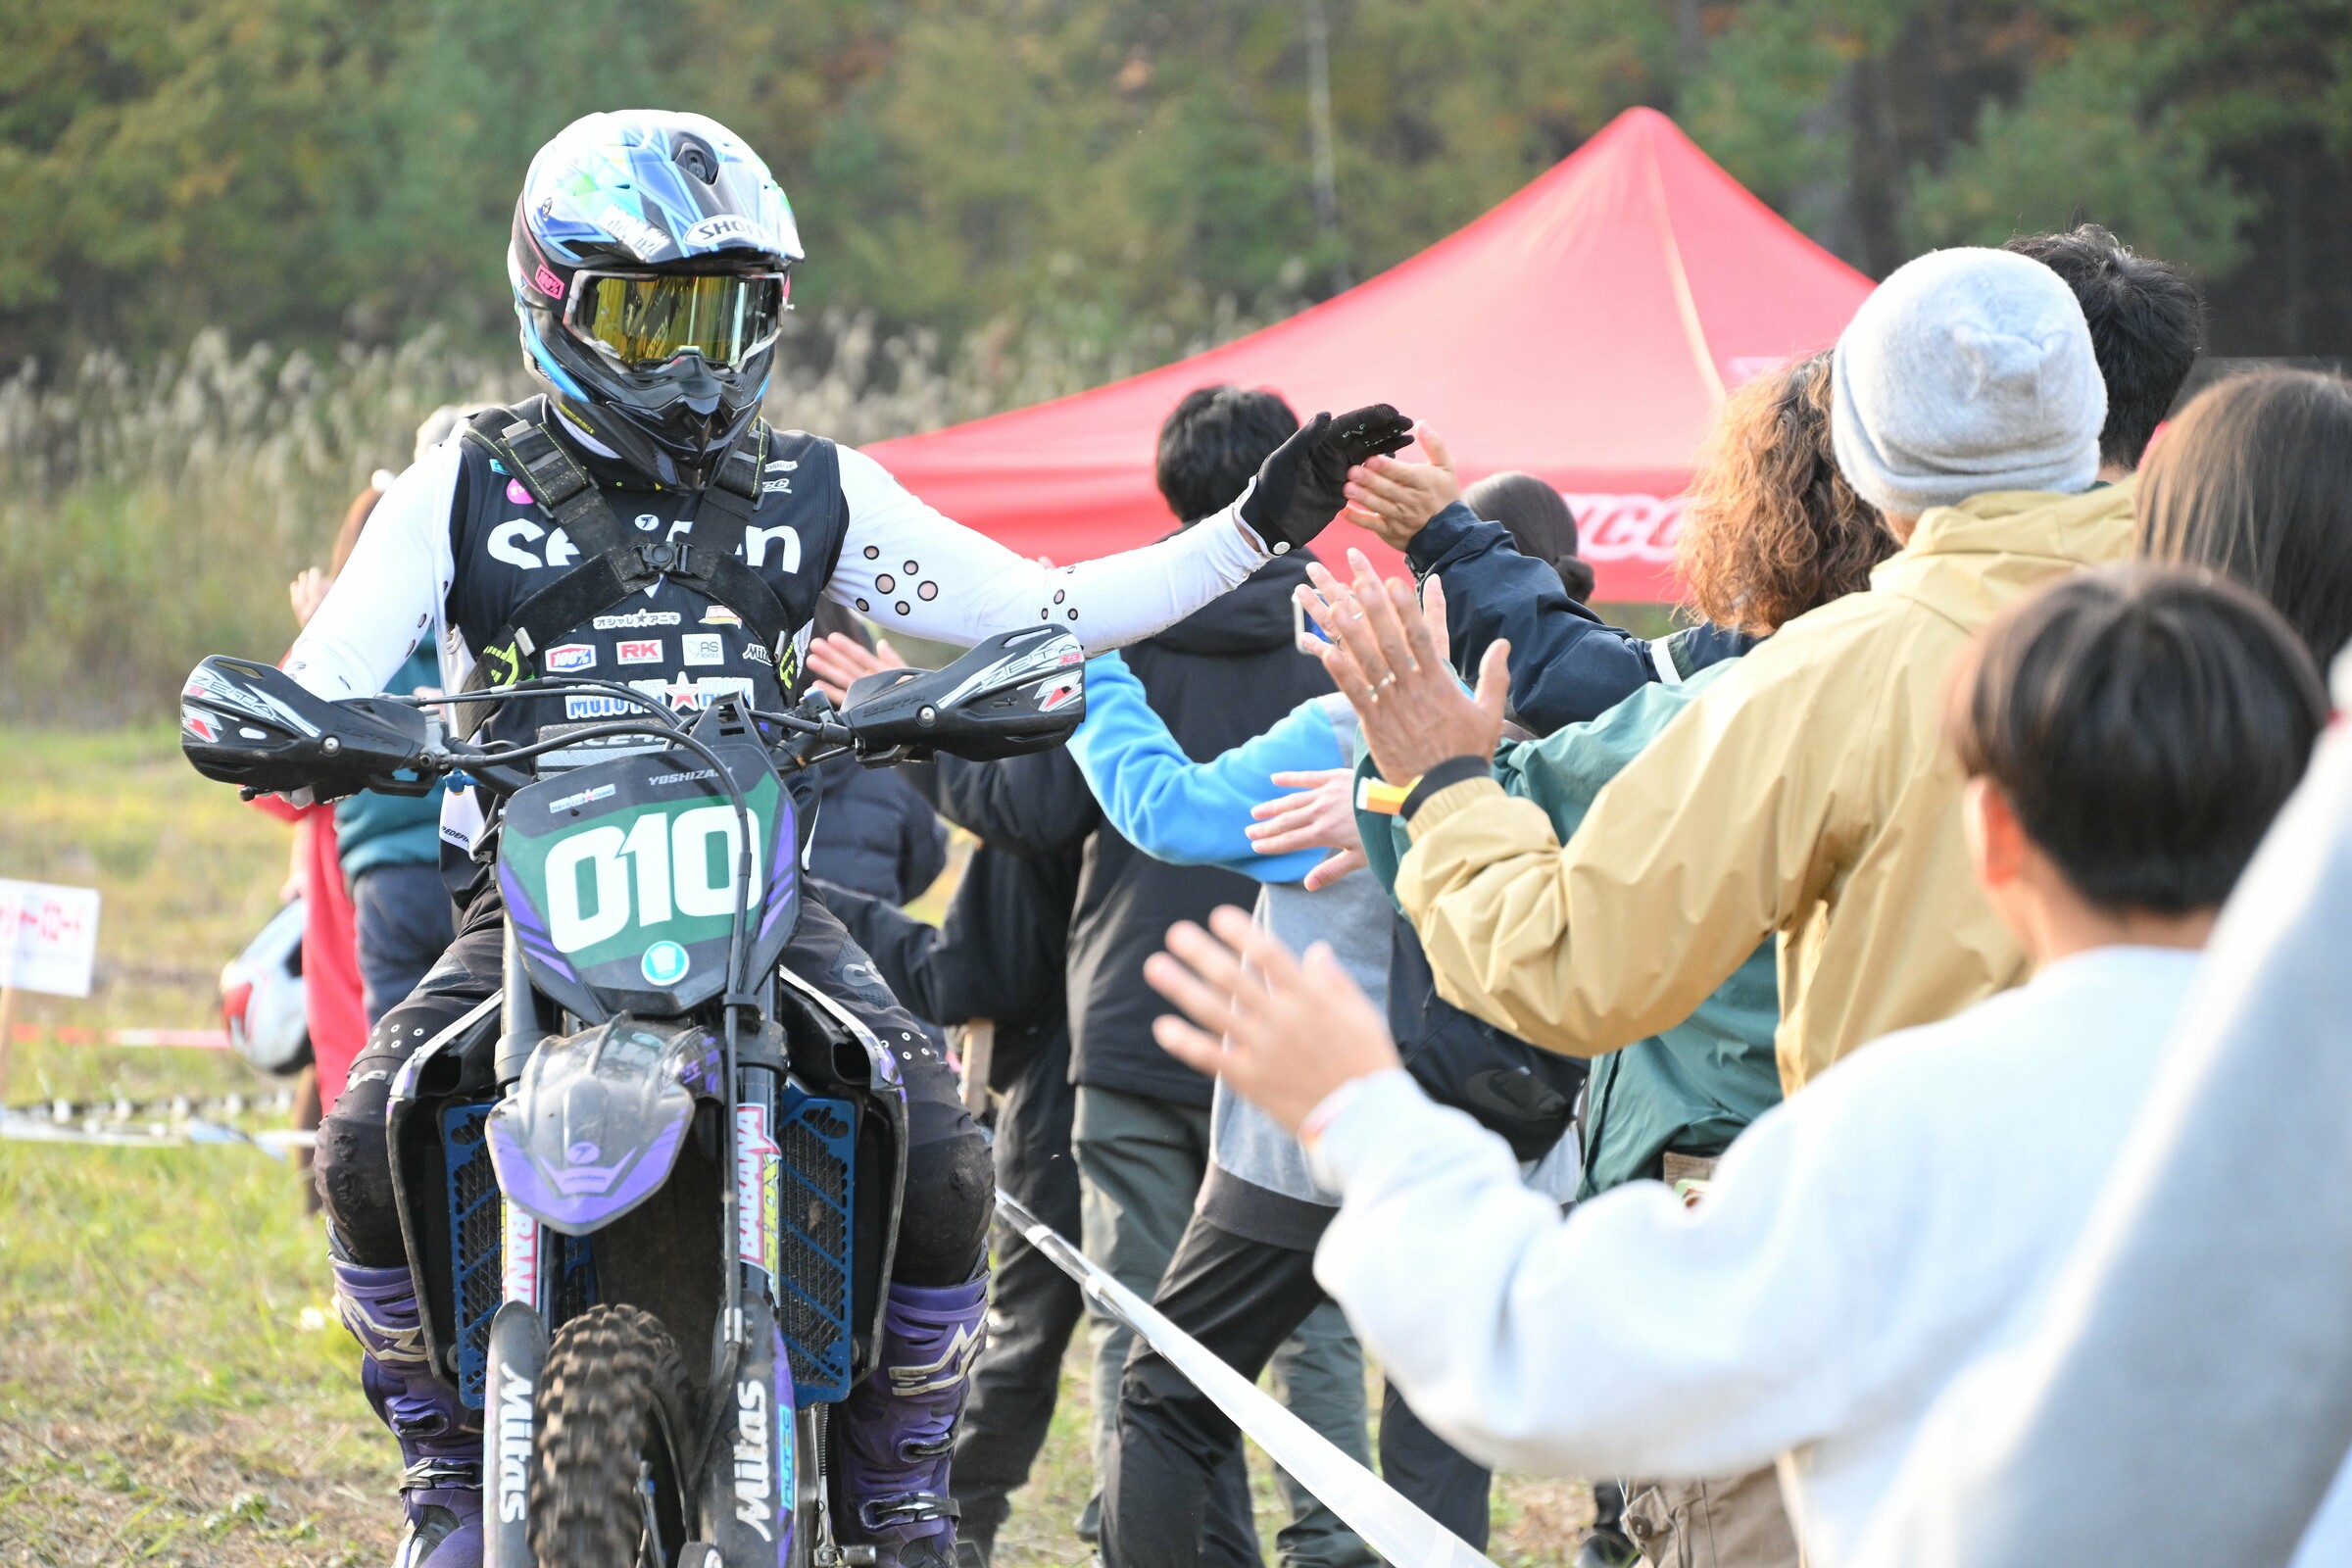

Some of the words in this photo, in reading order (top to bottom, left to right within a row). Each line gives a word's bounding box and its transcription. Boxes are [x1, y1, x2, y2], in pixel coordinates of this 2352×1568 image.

[538, 270, 559, 294] 100%
[639, 515, 655, 528] 7
[621, 642, 659, 659] RK
[700, 641, 719, 653] AS
[553, 649, 590, 666] 100%
[983, 643, 1078, 689] ZETA
[1058, 652, 1081, 665] X3
[648, 766, 733, 786] YOSHIZA
[545, 805, 762, 953] 010
[499, 1362, 533, 1524] Mitas
[736, 1380, 772, 1542] Mitas
